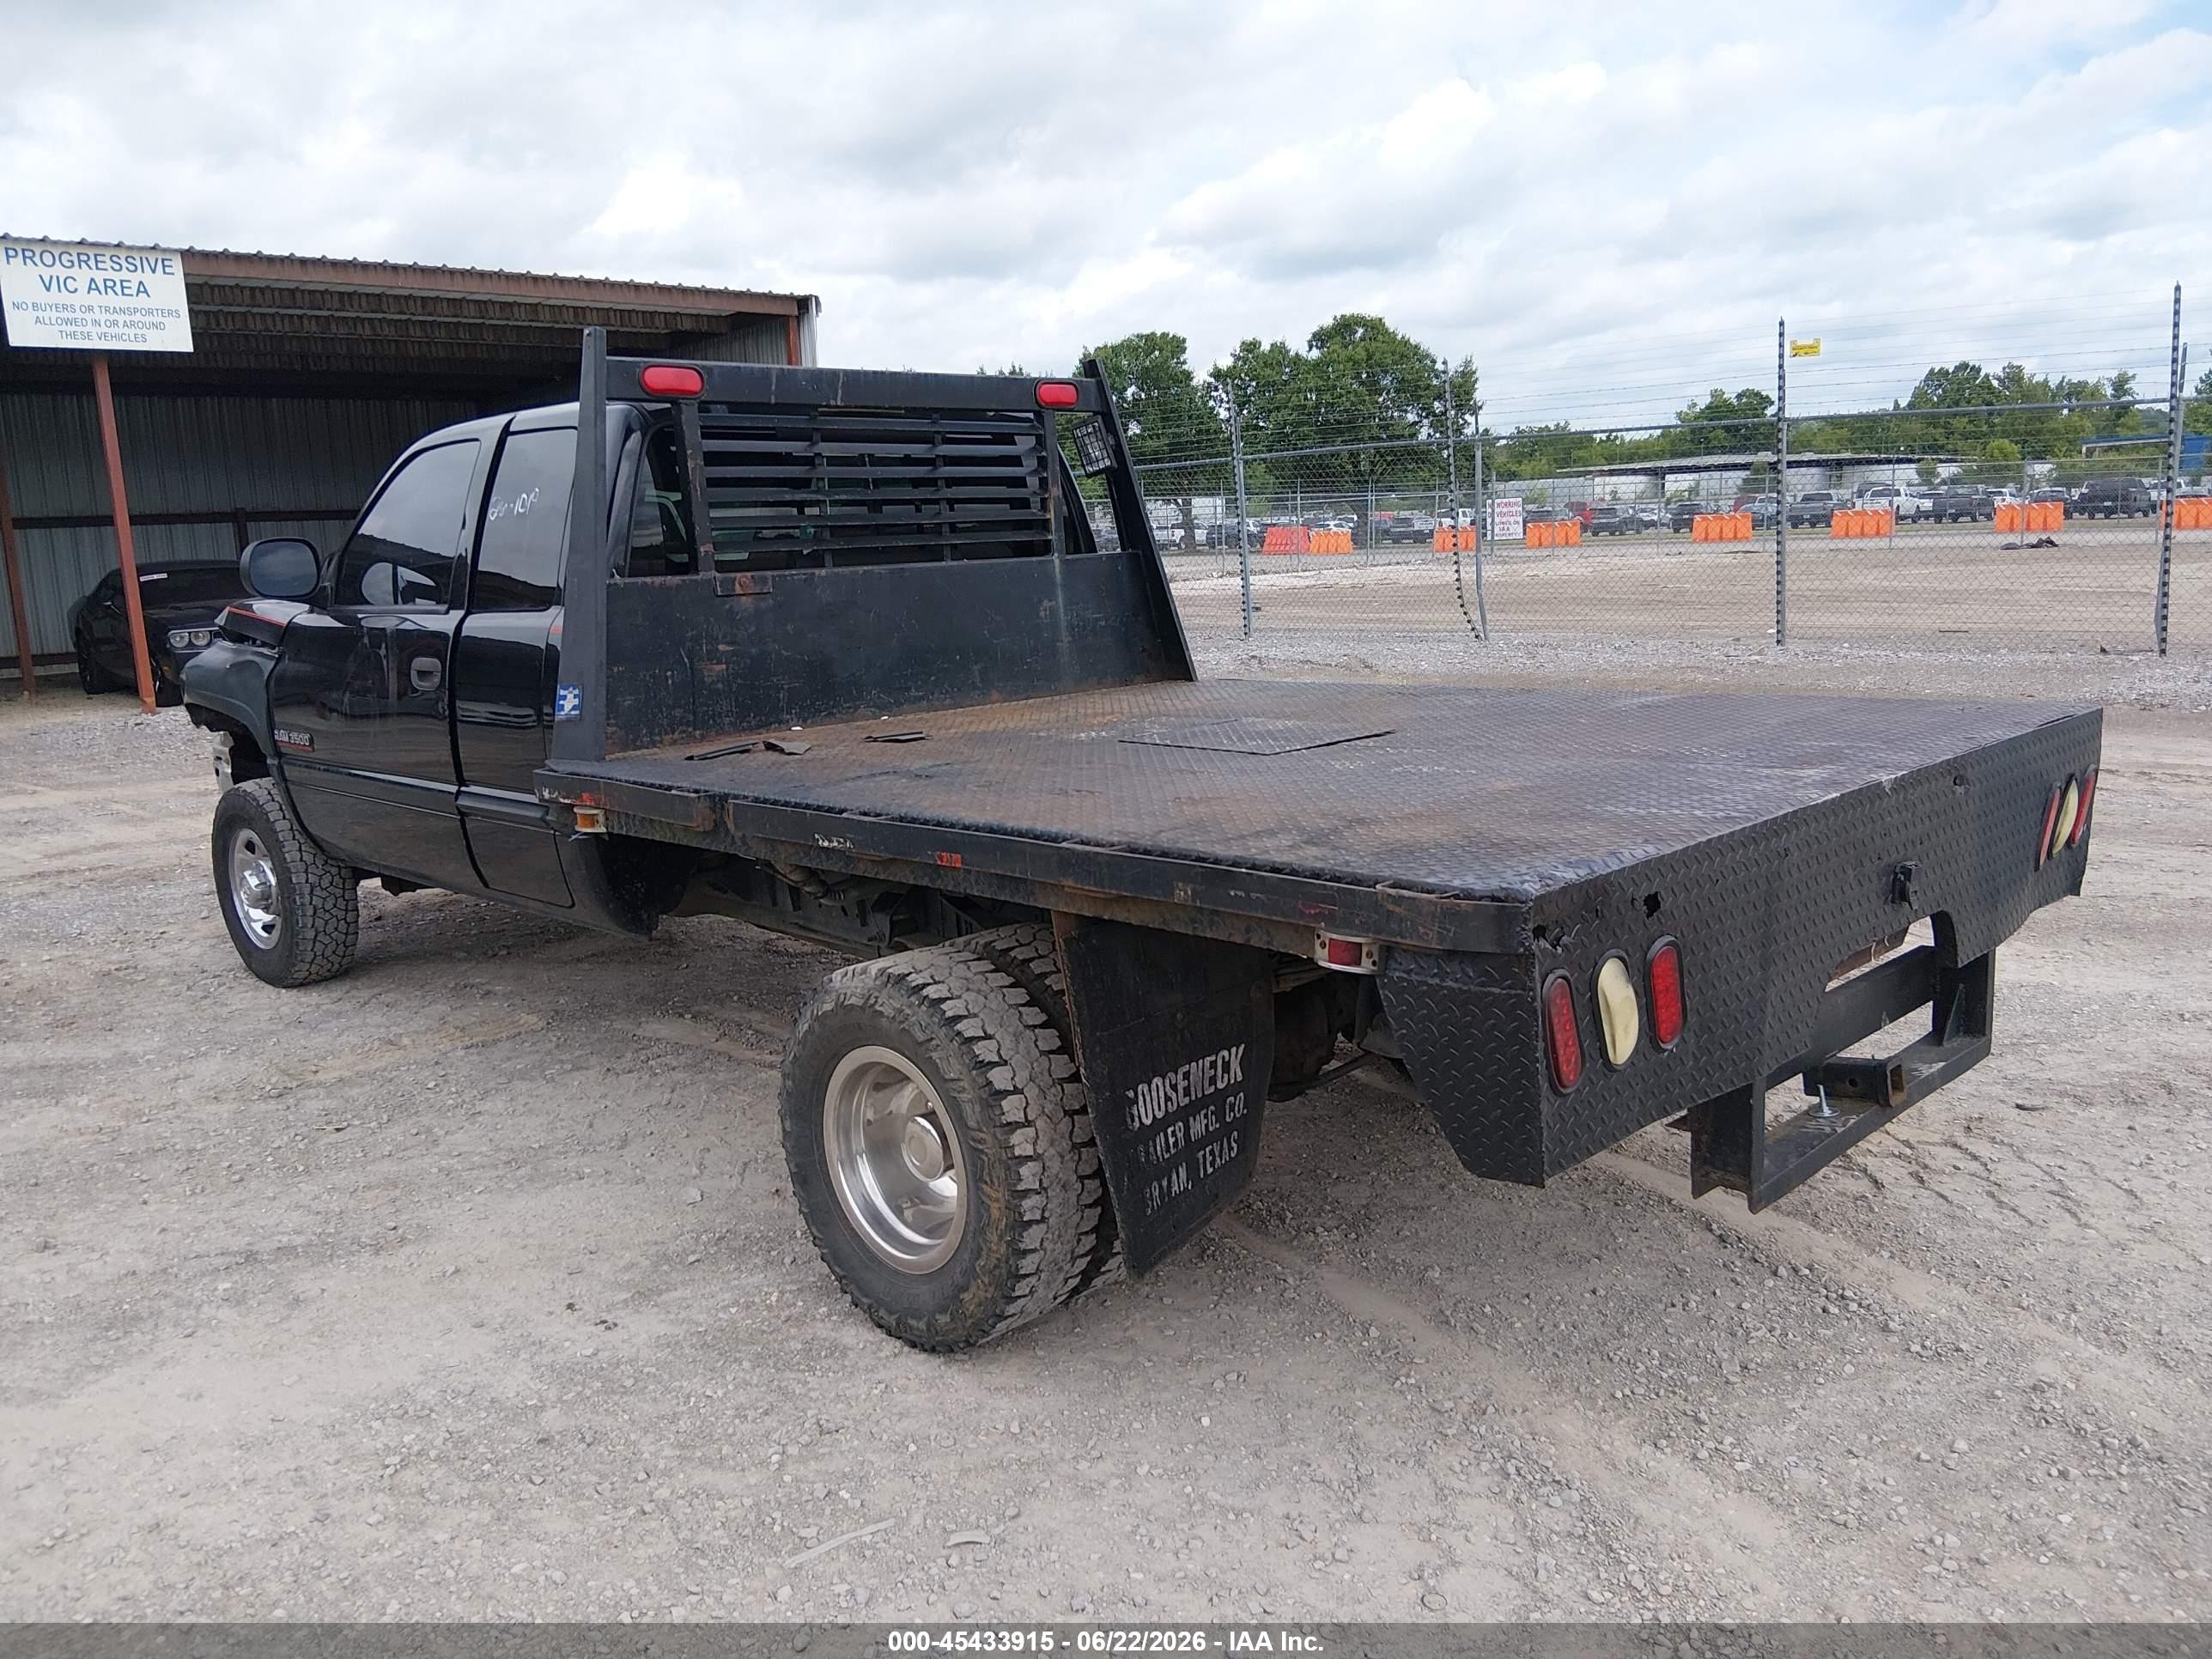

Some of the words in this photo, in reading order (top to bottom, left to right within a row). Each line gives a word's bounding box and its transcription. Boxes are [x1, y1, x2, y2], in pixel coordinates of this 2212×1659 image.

[3, 246, 175, 276] PROGRESSIVE
[39, 274, 78, 294] VIC
[87, 277, 151, 298] AREA
[12, 301, 28, 311] NO
[33, 302, 76, 313] BUYERS
[79, 305, 95, 315] OR
[98, 306, 180, 319] TRANSPORTERS
[34, 316, 88, 327] ALLOWED
[91, 319, 101, 328] IN
[104, 319, 120, 329] OR
[123, 320, 166, 331] AROUND
[58, 330, 94, 341] THESE
[96, 331, 148, 343] VEHICLES
[289, 732, 310, 745] 3500
[1188, 1105, 1220, 1142] MFG.
[1224, 1091, 1248, 1123] CO.
[1196, 1130, 1238, 1179] TEXAS
